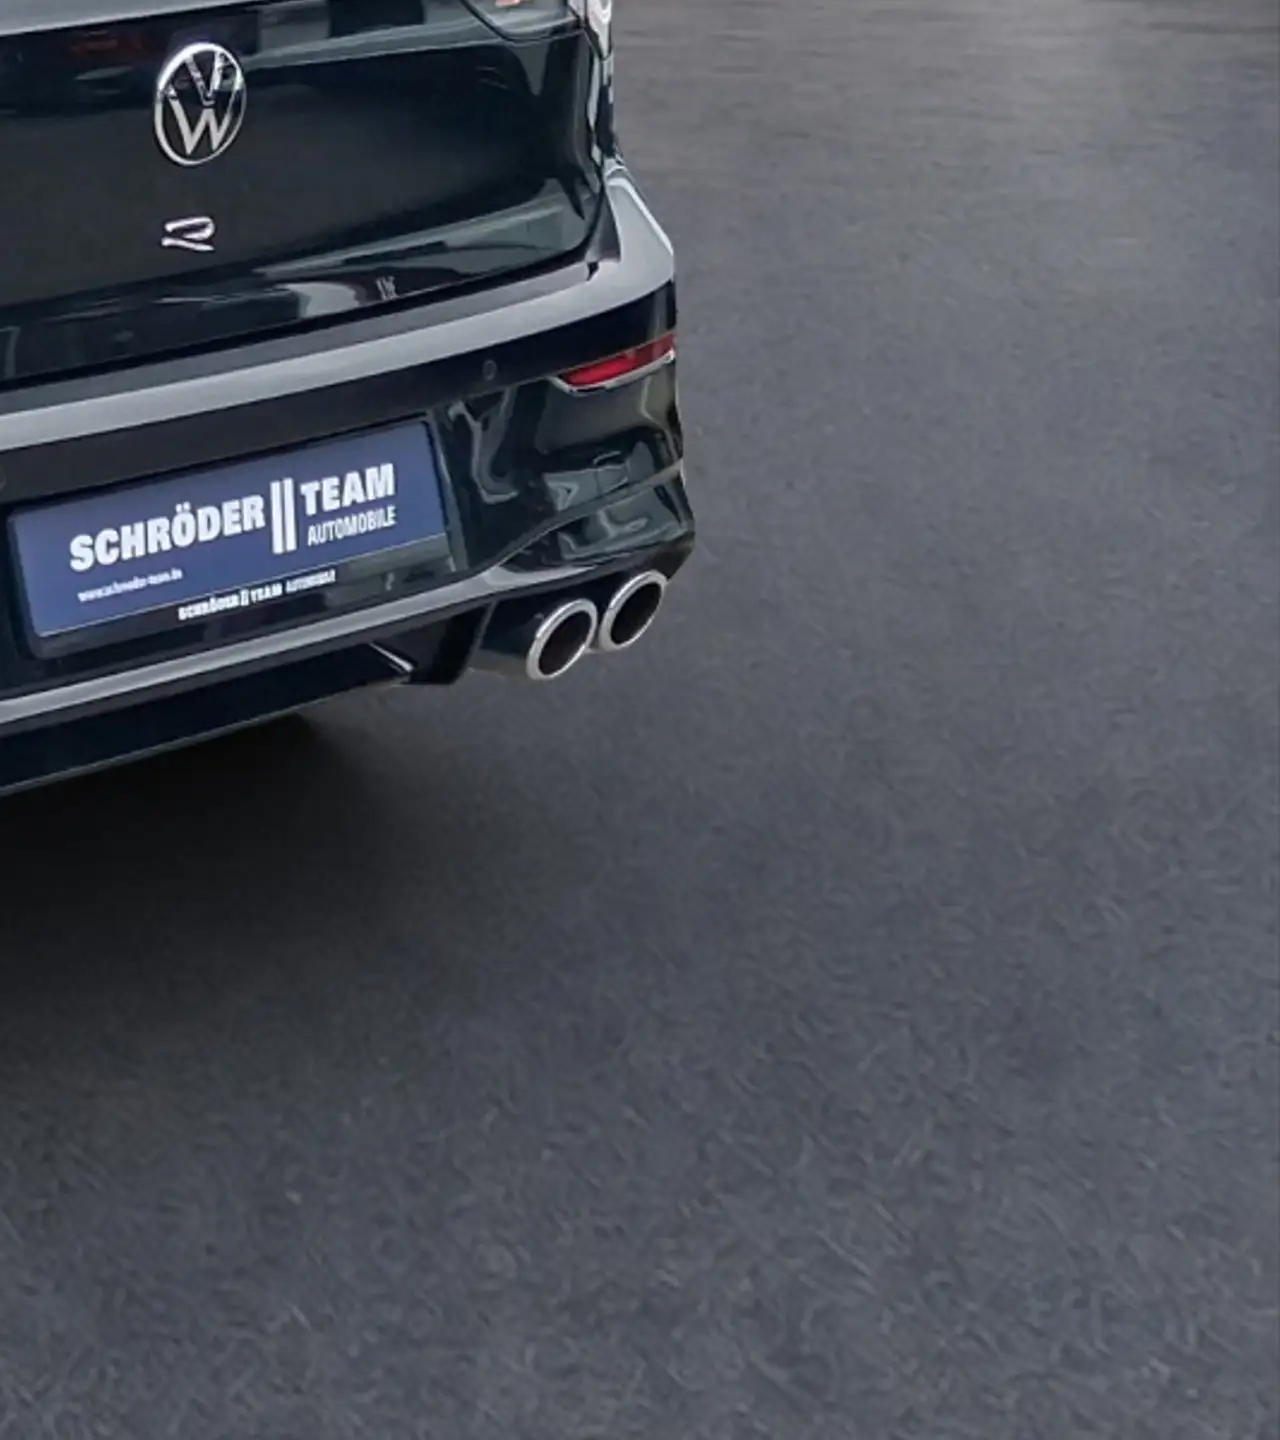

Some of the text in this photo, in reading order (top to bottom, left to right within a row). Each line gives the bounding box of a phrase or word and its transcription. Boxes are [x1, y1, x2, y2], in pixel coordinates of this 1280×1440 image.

[69, 462, 395, 572] SCHRÖDER TEAM
[307, 505, 397, 547] AUTOMOBILE
